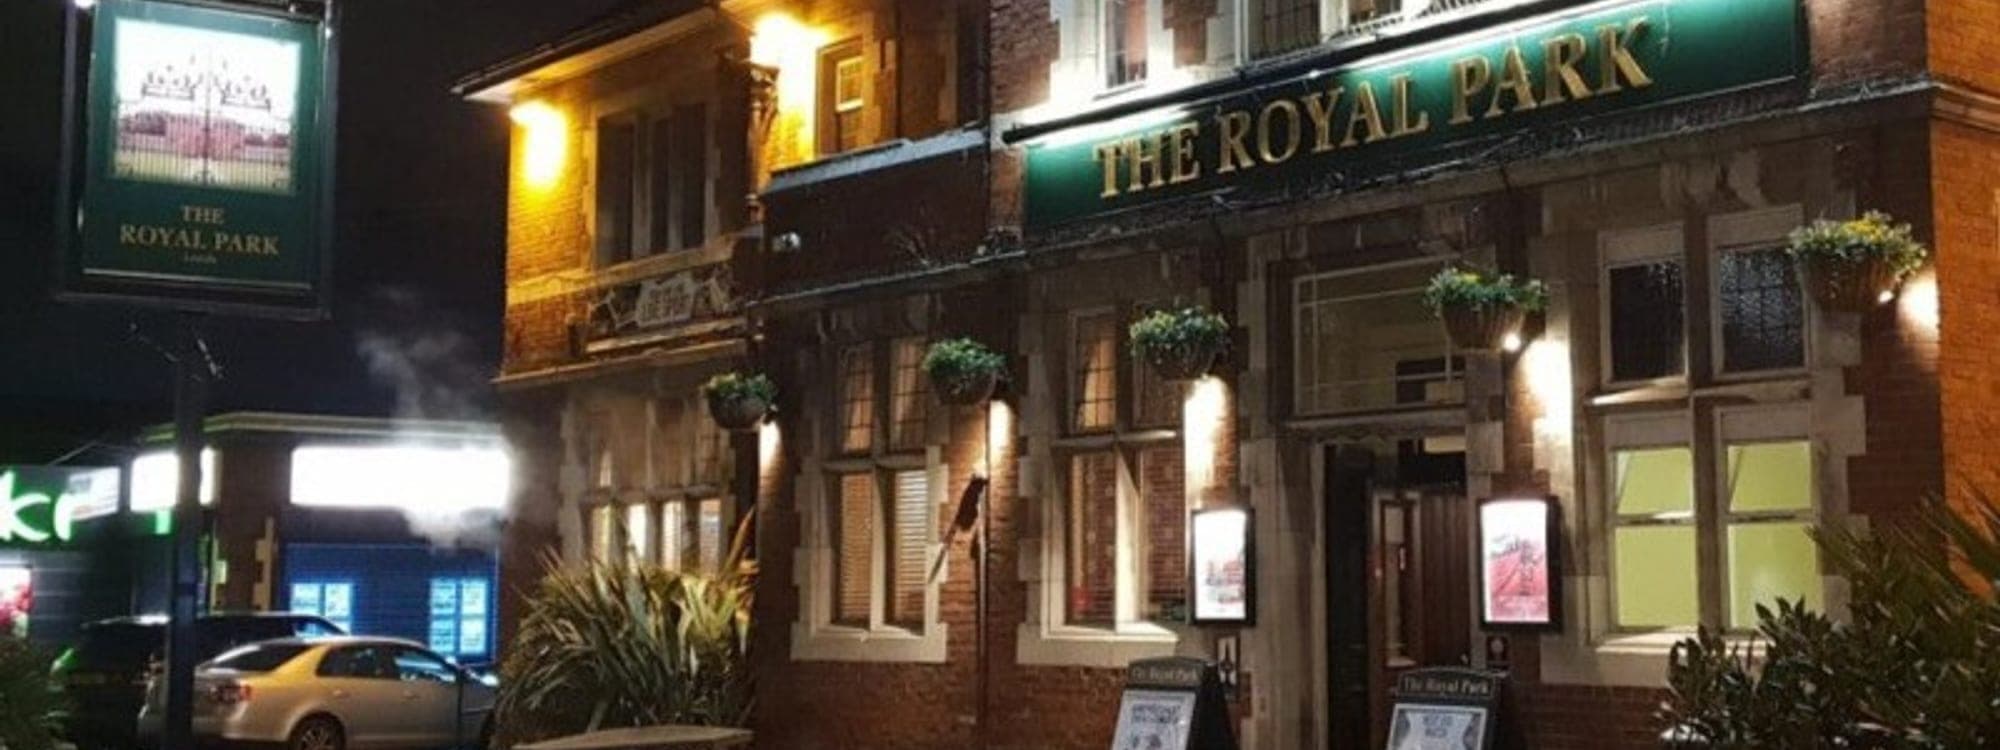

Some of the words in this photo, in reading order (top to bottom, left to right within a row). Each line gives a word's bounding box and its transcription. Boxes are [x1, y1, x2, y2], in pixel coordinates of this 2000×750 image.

[1094, 121, 1199, 200] THE
[1216, 74, 1428, 174] ROYAL
[1450, 17, 1653, 124] PARK
[182, 205, 225, 224] THE
[120, 224, 206, 249] ROYAL
[214, 233, 280, 255] PARK
[1462, 678, 1489, 693] Park
